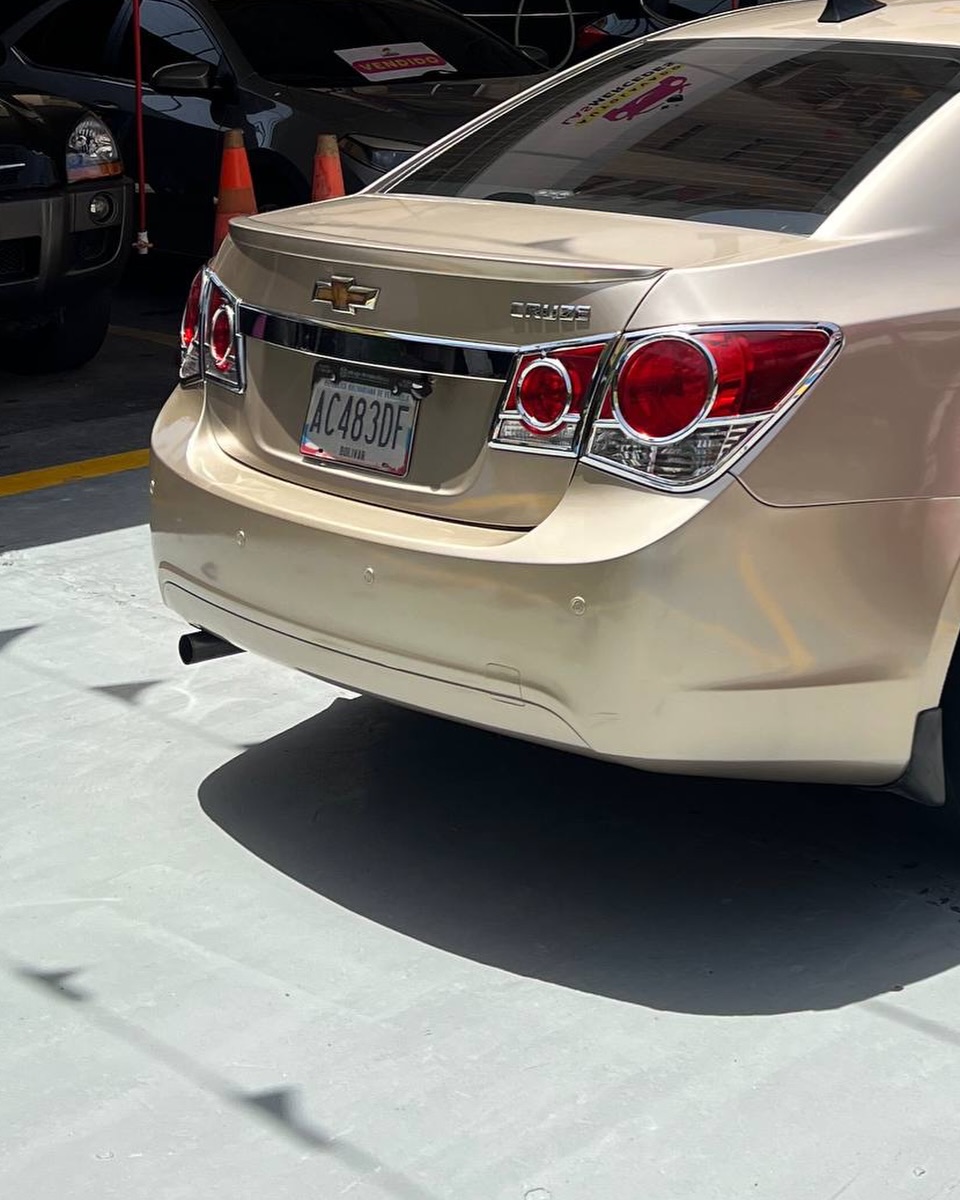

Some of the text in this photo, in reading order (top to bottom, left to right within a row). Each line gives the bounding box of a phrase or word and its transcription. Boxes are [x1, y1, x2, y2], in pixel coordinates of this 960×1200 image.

[360, 55, 439, 71] VENDIDO
[511, 302, 591, 321] CRUZE
[309, 390, 410, 450] AC483DF
